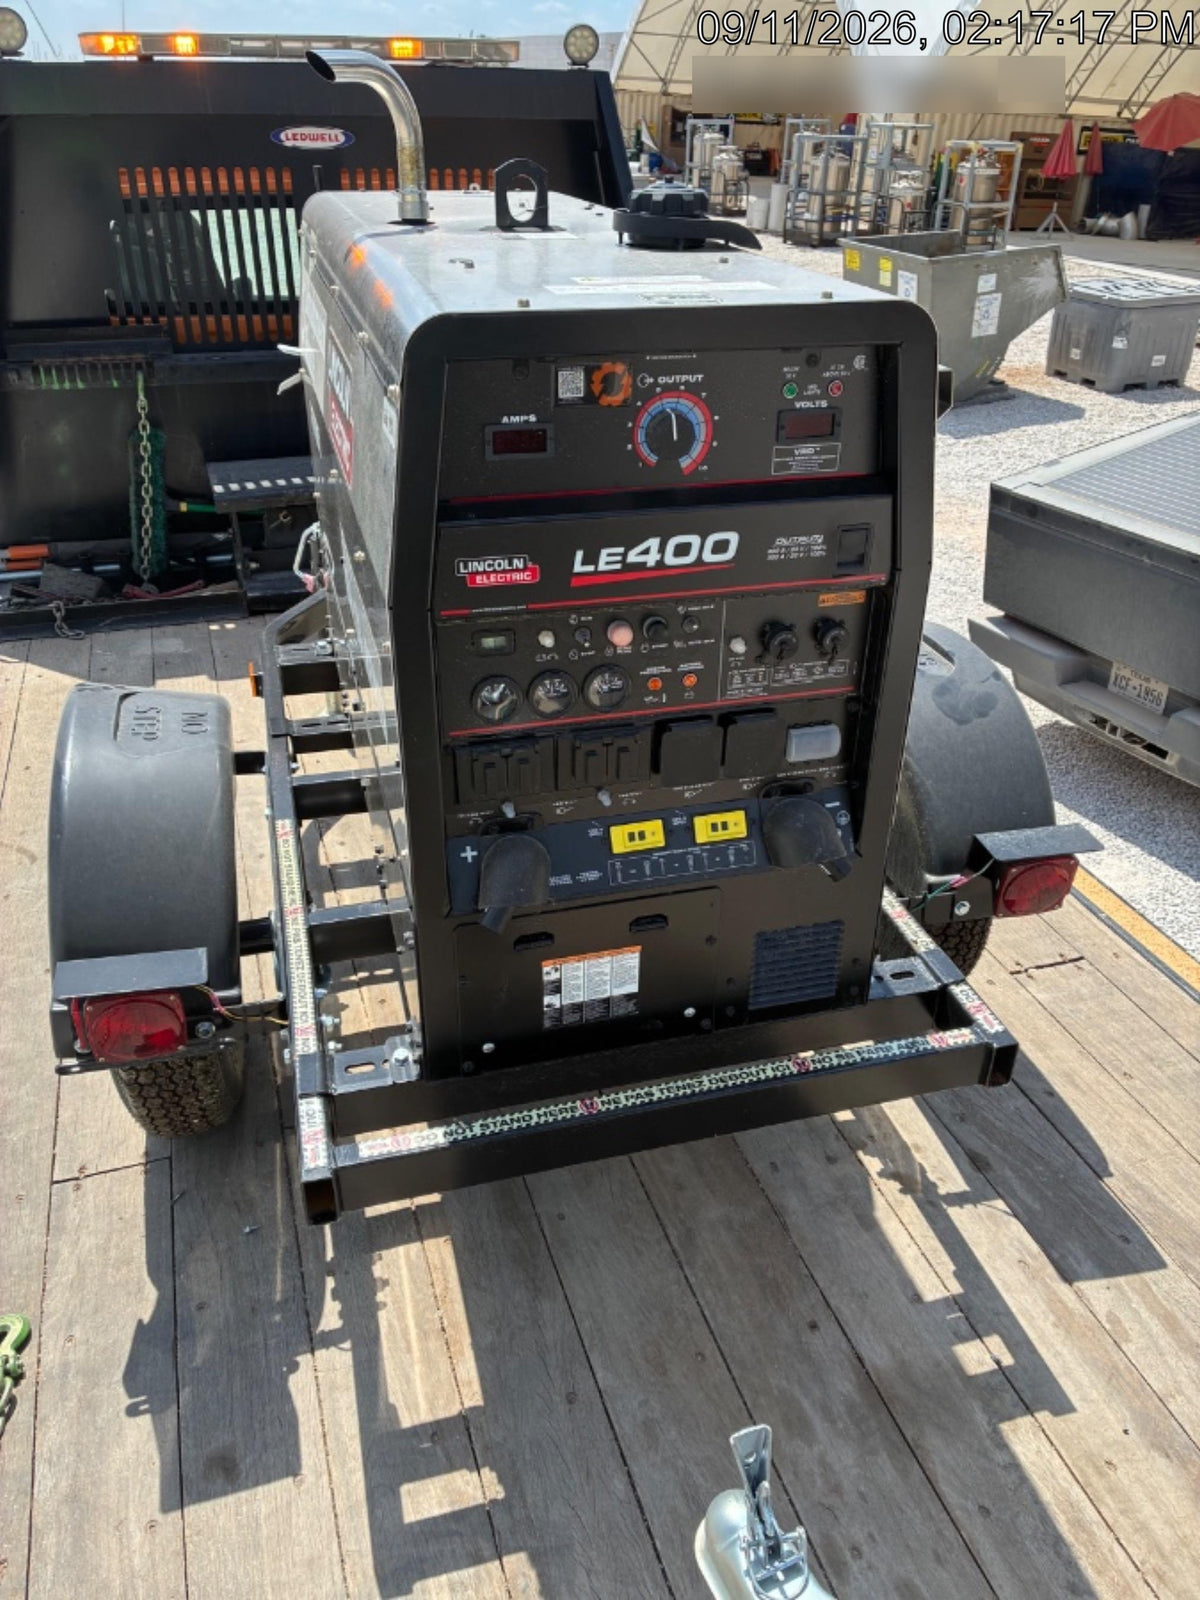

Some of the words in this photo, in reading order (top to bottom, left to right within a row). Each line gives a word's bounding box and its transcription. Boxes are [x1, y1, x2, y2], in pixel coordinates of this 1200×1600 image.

[284, 132, 341, 142] LEDWELL
[657, 374, 704, 384] OUTPUT
[794, 400, 828, 409] VOLTS
[501, 413, 537, 424] AMPS
[571, 531, 741, 574] LE400
[459, 557, 525, 574] LINCOLN
[475, 571, 532, 585] ELECTRIC
[810, 1055, 833, 1066] NO
[624, 1090, 656, 1102] PAS
[707, 1067, 768, 1085] DEBOUT
[443, 1123, 475, 1139] NOT
[480, 1113, 534, 1130] STAND
